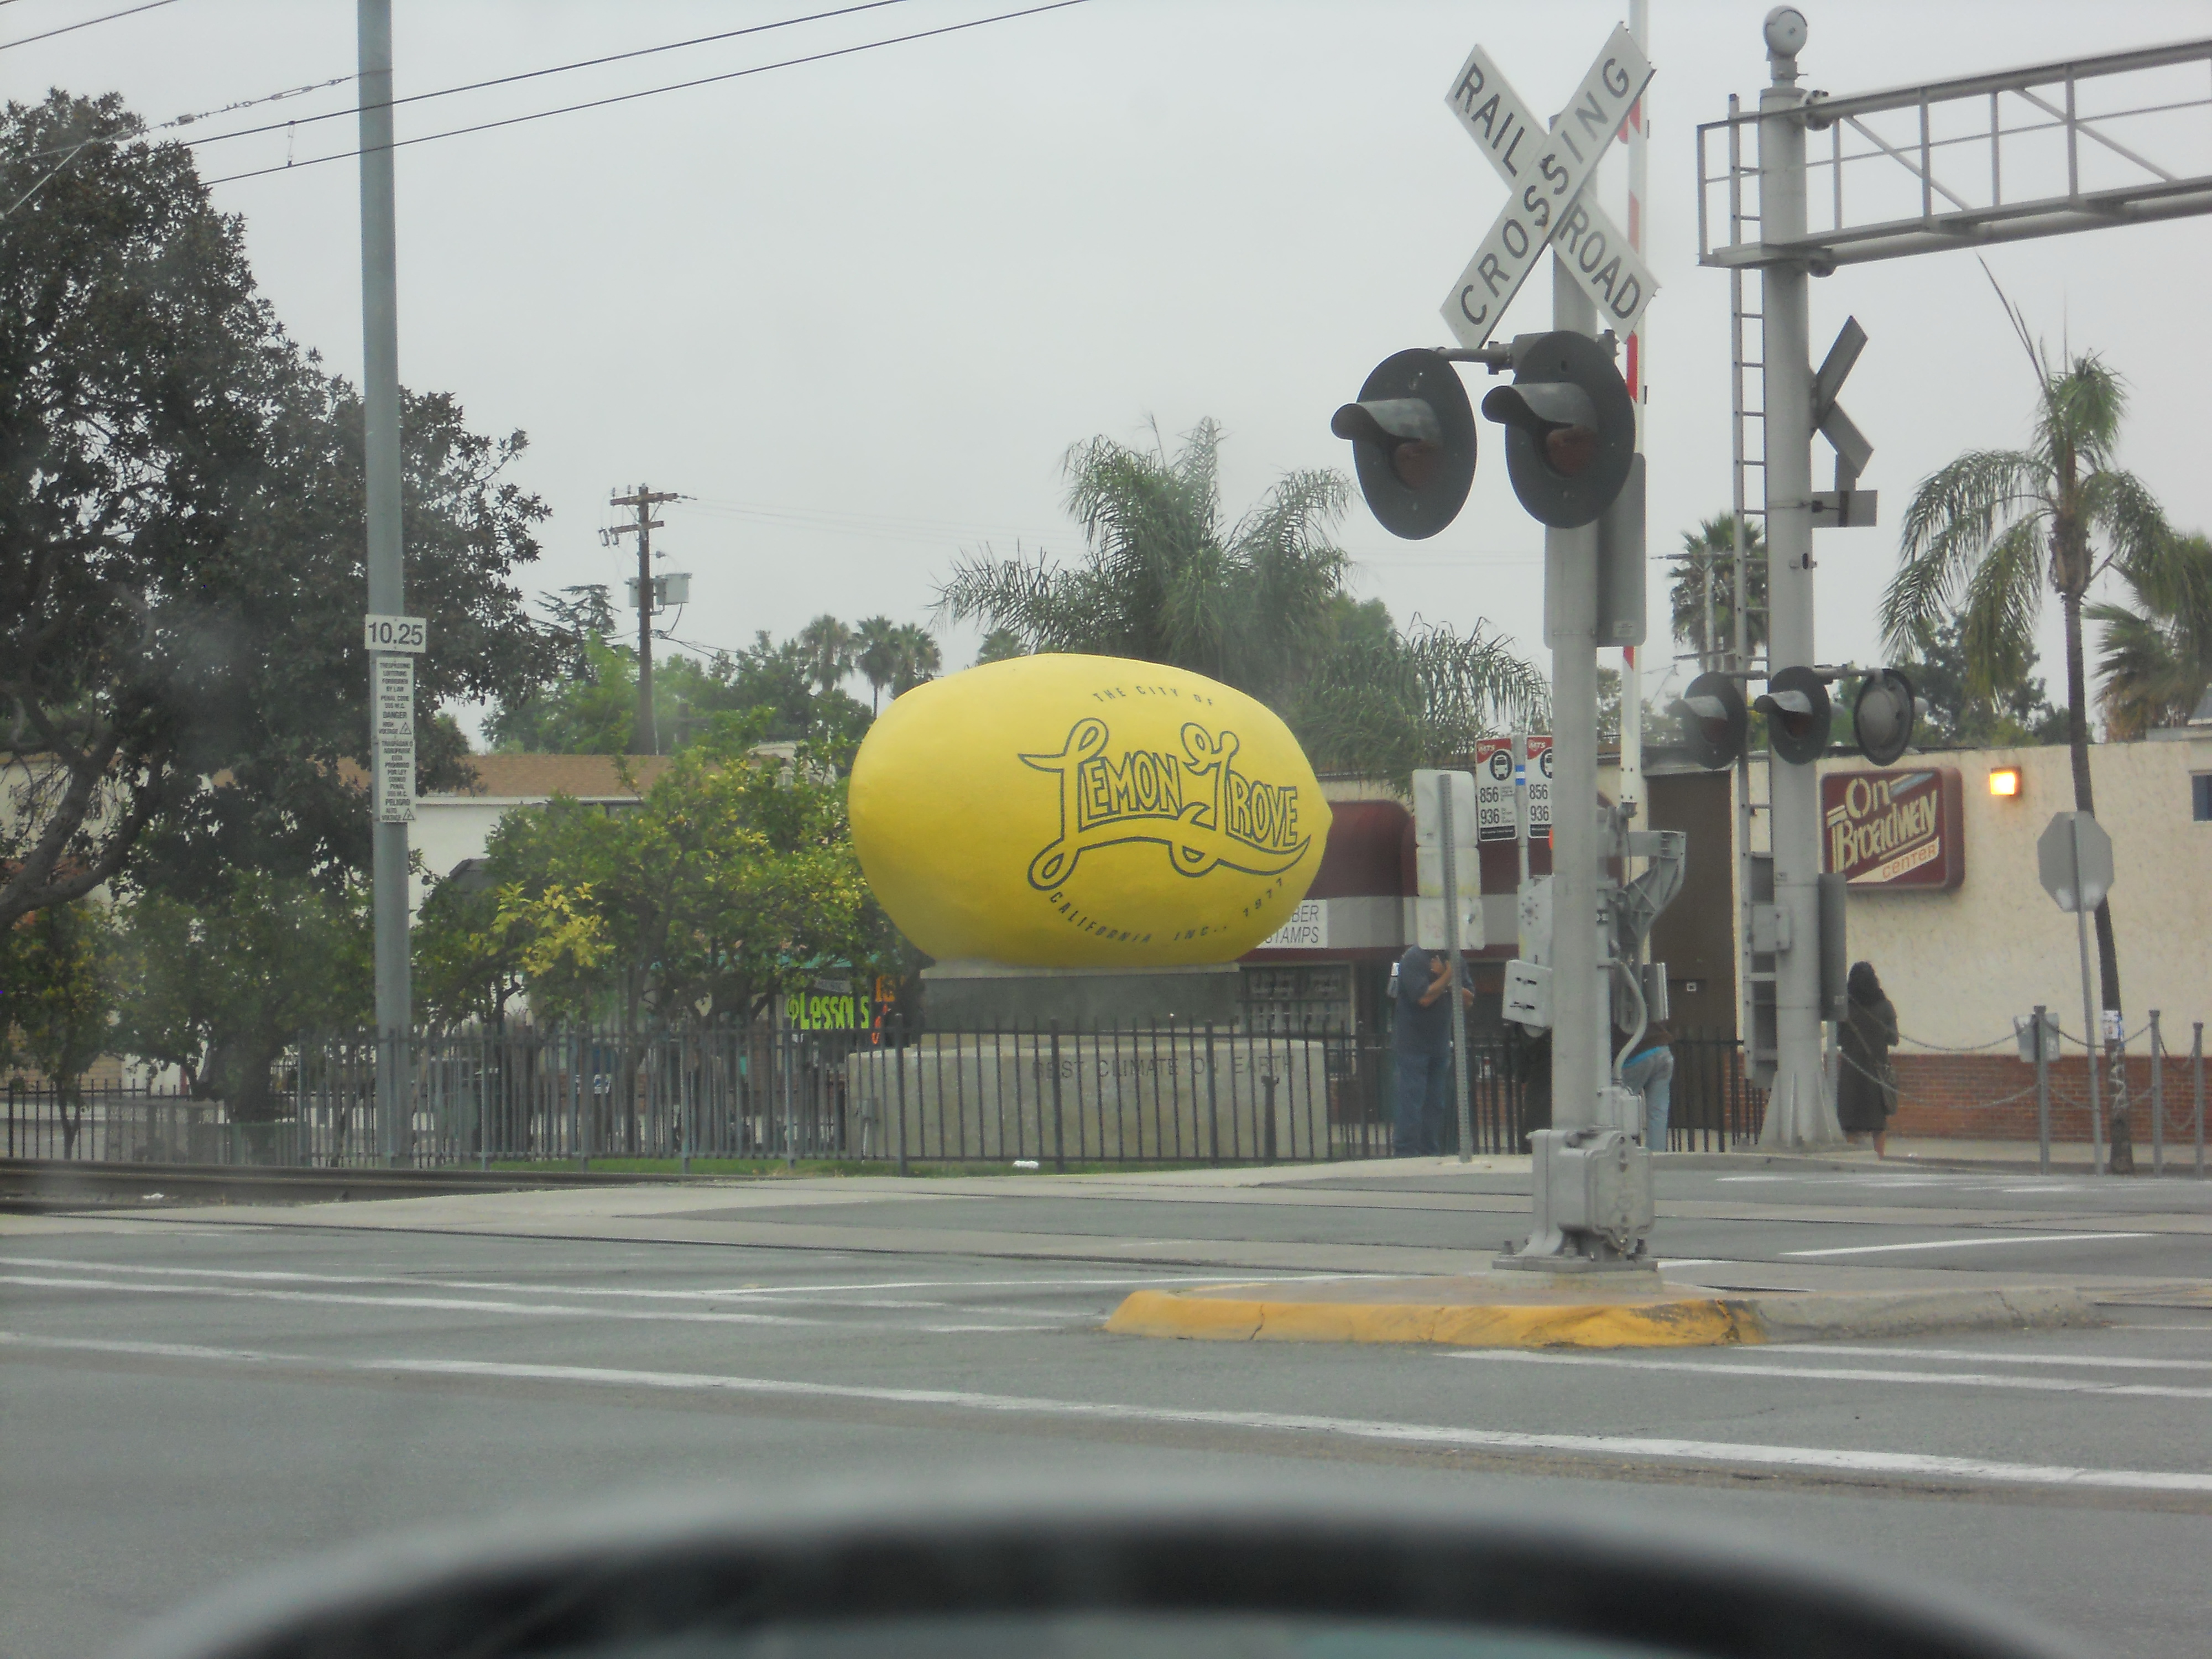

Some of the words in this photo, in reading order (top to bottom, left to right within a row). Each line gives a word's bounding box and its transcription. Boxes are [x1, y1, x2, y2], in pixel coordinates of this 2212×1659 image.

[1454, 62, 1525, 177] RAIL
[1460, 58, 1630, 326] CROSSING
[1558, 204, 1641, 320] ROAD
[368, 622, 423, 646] 10.25
[1093, 687, 1126, 702] THE
[1136, 686, 1178, 697] CITY
[1193, 694, 1213, 706] OF
[1480, 786, 1499, 803] 856
[1530, 784, 1548, 799] 856
[1845, 778, 1891, 818] On
[1018, 717, 1183, 891] LEMON
[1168, 722, 1312, 878] GROVE
[1531, 806, 1549, 821] 936
[1481, 808, 1499, 825] 936
[1051, 891, 1151, 942] CALIFORNIA
[1243, 877, 1282, 917] 1977
[1098, 1058, 1179, 1077] CLIMATE
[1234, 1055, 1294, 1074] EARTH
